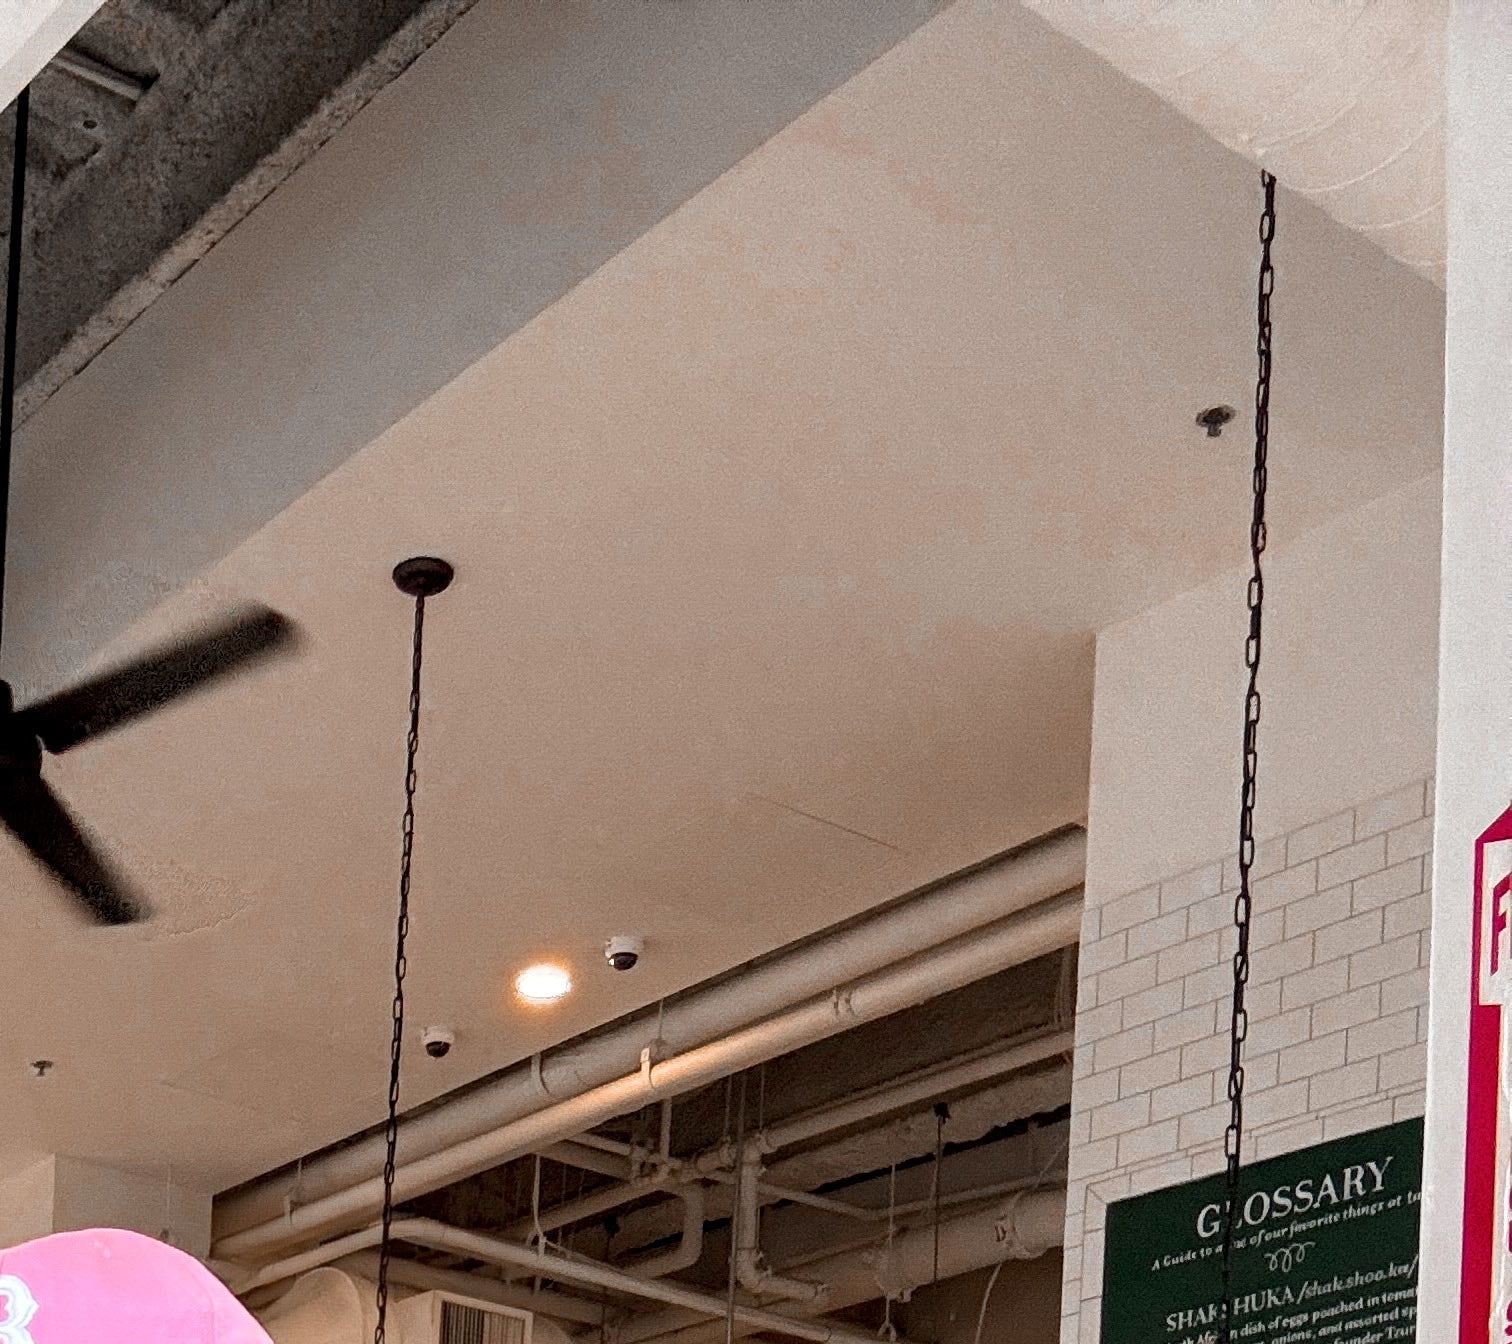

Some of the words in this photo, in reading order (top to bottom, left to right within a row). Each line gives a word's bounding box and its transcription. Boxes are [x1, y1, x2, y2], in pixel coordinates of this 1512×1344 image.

[1197, 1157, 1393, 1238] GOSSARY
[1342, 1202, 1384, 1219] things
[1240, 1322, 1265, 1336] dish
[1312, 1297, 1364, 1322] poached
